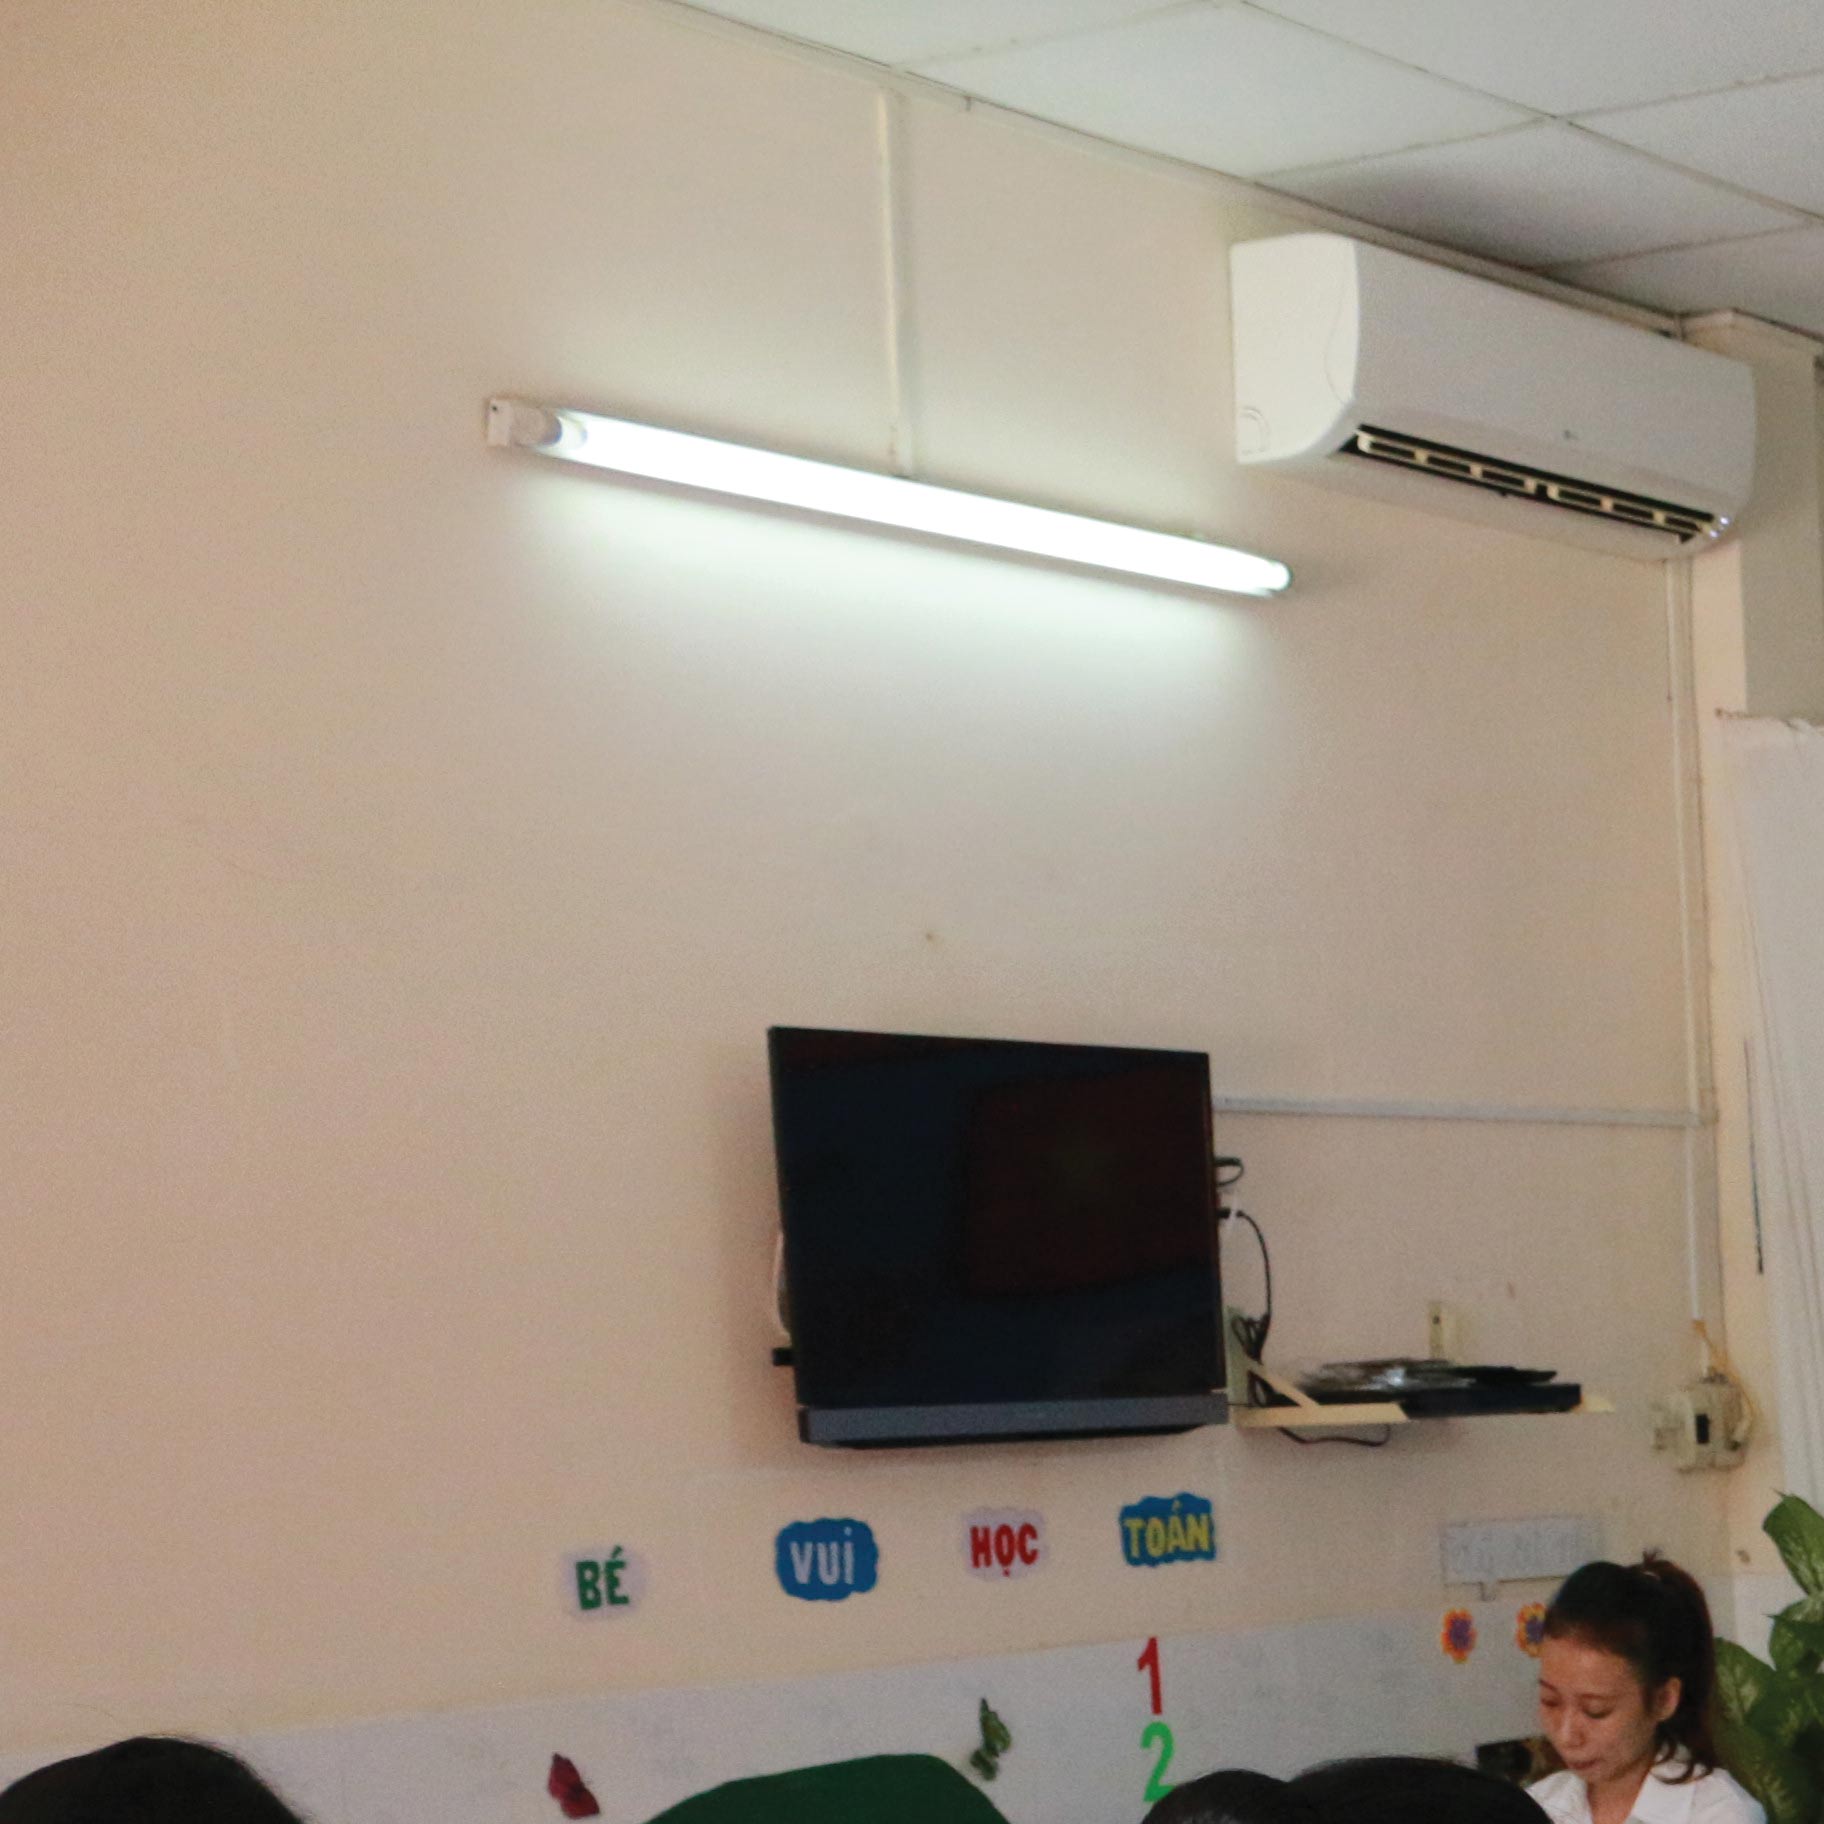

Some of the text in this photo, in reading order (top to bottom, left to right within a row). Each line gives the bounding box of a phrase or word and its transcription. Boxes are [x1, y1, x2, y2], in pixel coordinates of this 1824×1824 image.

[575, 1545, 630, 1611] BÉ
[969, 1523, 1039, 1578] HỌC
[1137, 1636, 1162, 1715] 1
[1141, 1722, 1176, 1802] 2
